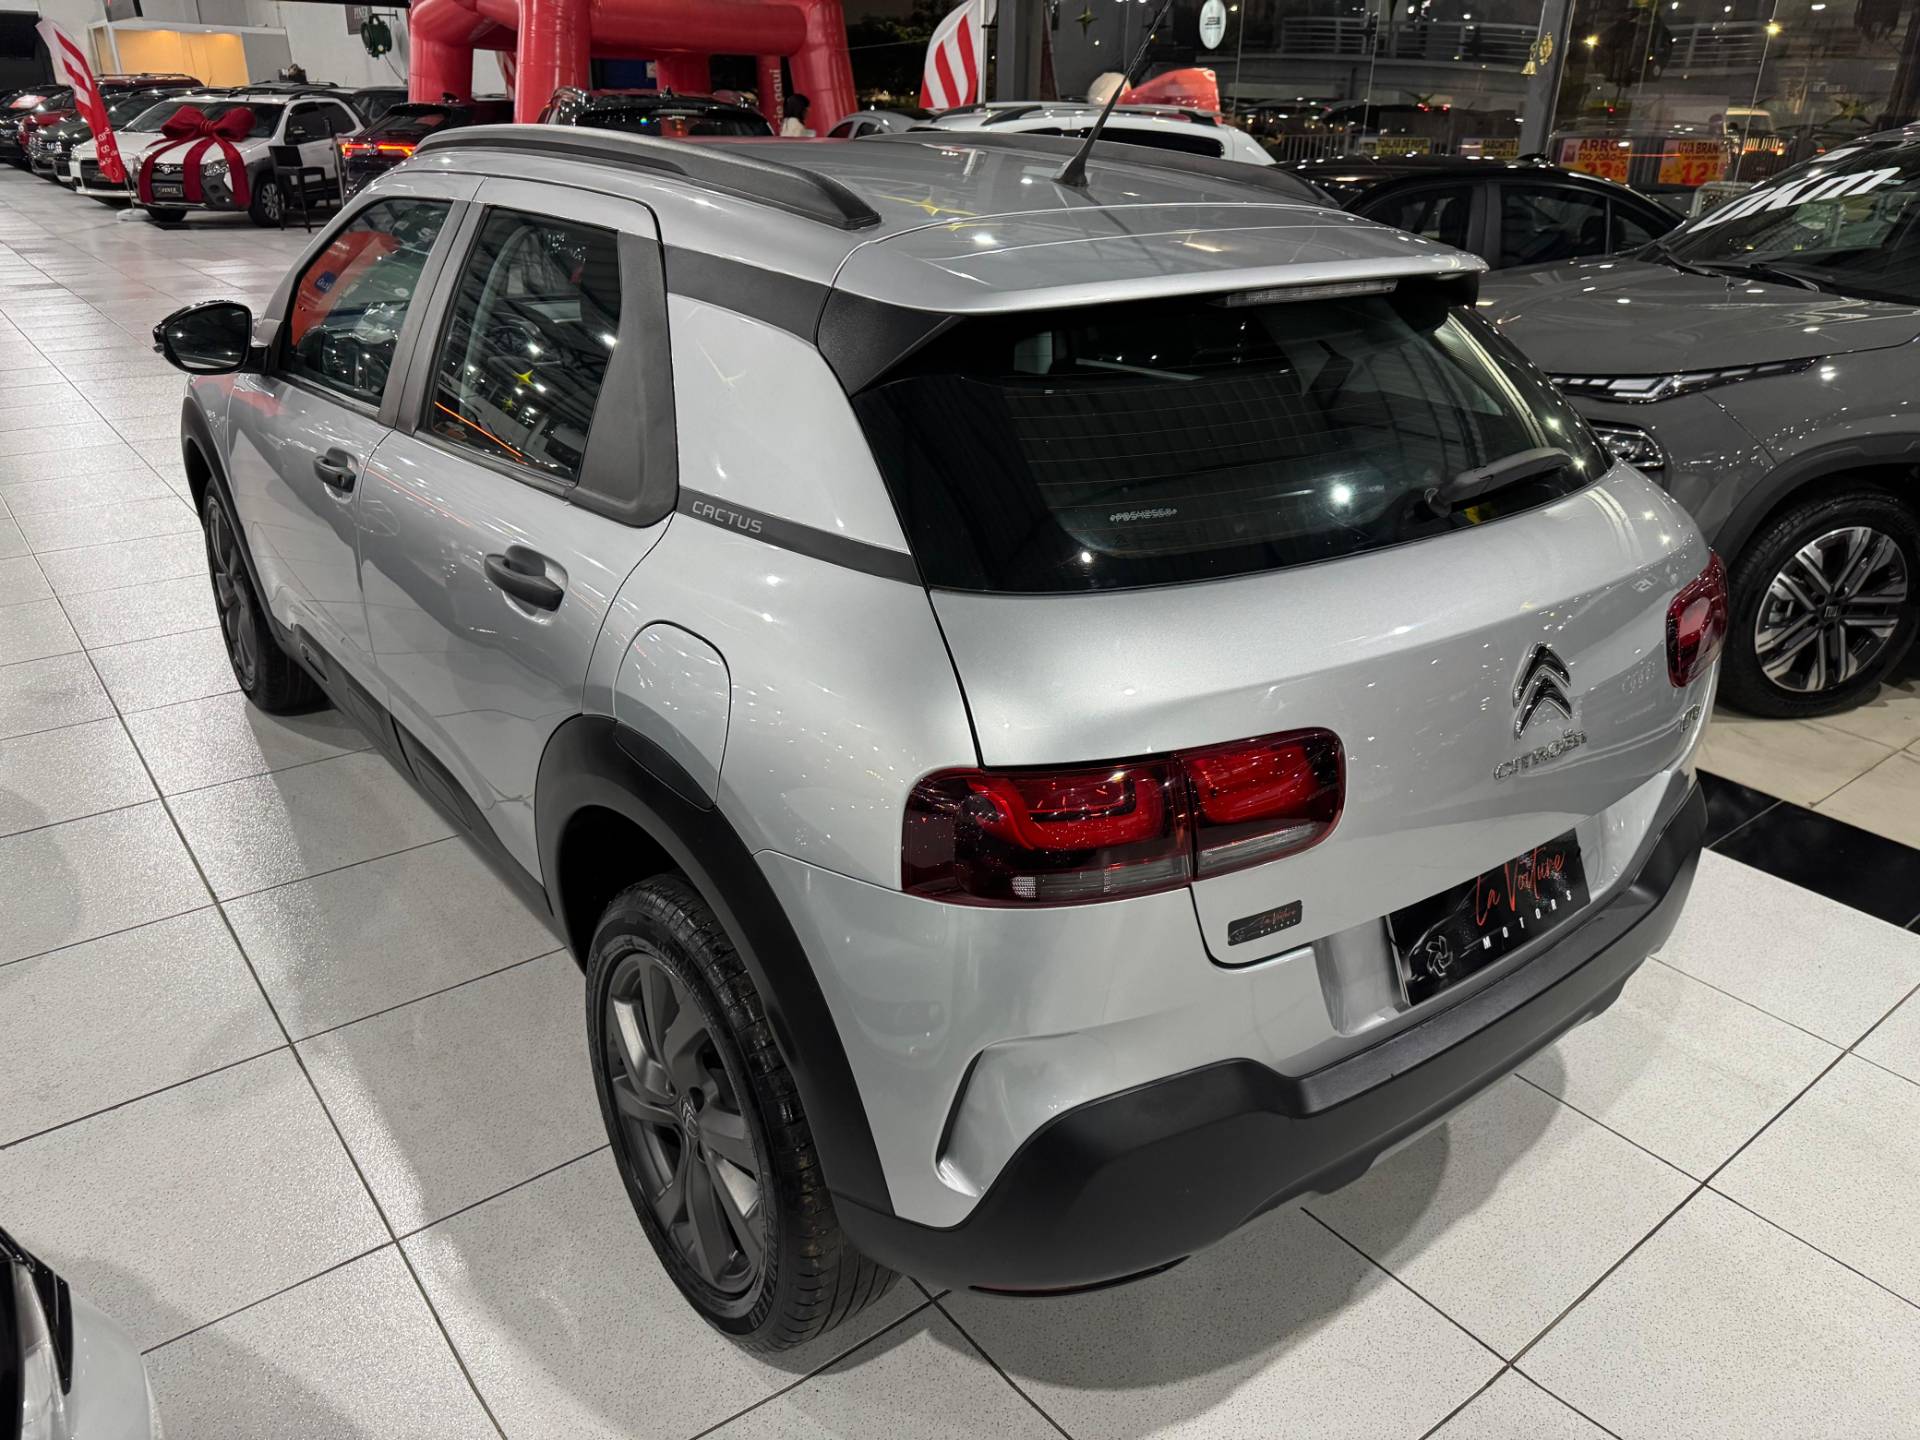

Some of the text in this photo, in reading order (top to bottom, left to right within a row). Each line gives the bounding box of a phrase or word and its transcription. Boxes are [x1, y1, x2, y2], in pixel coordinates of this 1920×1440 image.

[692, 500, 763, 534] CACTUS
[1476, 875, 1501, 926] La
[1482, 889, 1573, 950] MOTORS
